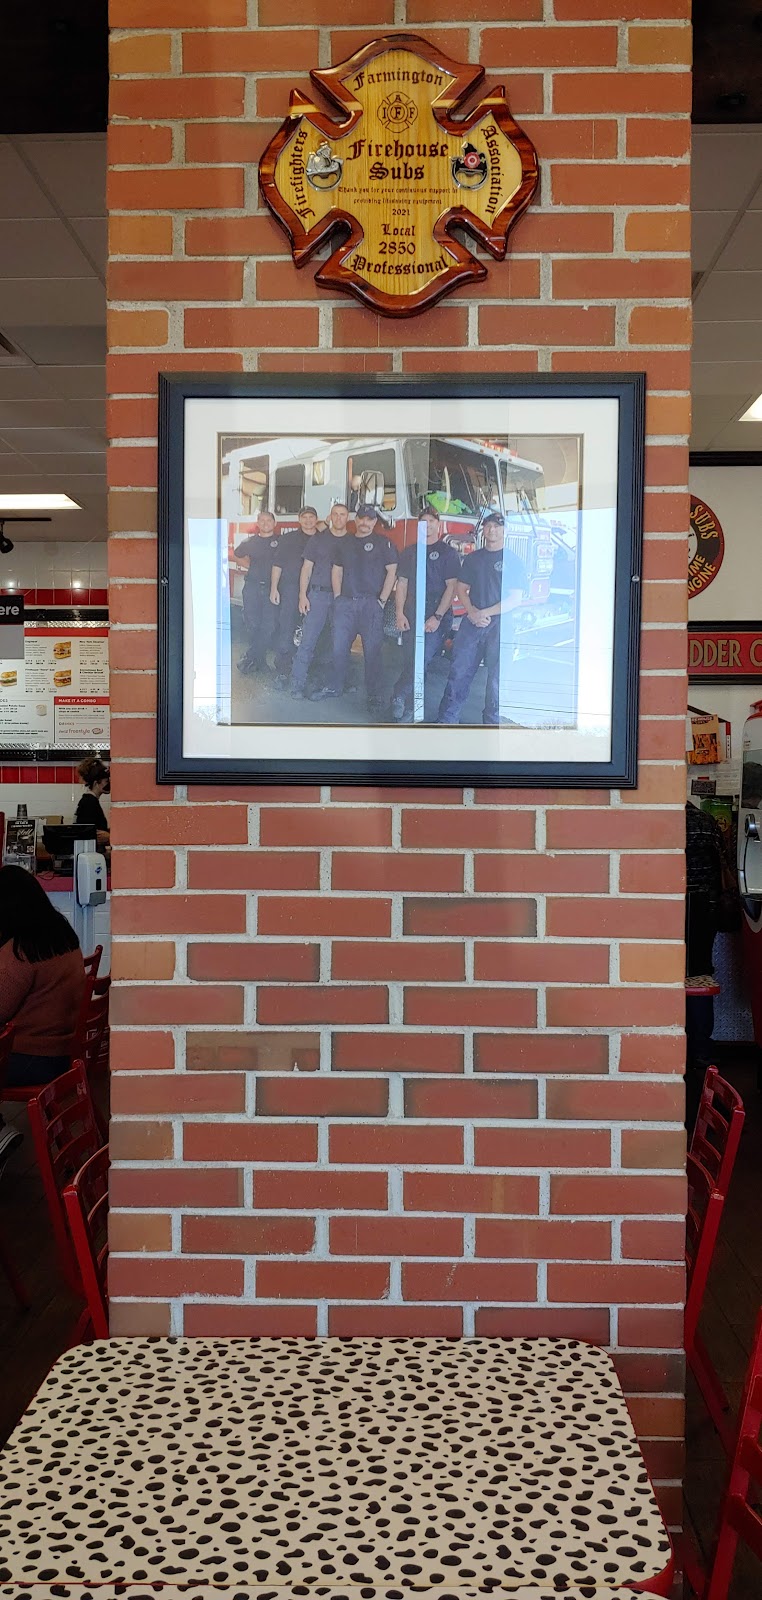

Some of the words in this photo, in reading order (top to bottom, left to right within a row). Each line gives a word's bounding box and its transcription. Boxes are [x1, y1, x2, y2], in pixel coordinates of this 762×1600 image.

[353, 68, 443, 91] Farmington
[346, 139, 449, 160] Firehouse
[289, 128, 315, 218] Firefighters
[369, 162, 424, 180] Subs
[480, 125, 504, 214] Association
[392, 208, 410, 216] 2021
[381, 223, 415, 236] Local
[379, 241, 416, 254] 2850
[350, 254, 448, 275] Professional
[690, 505, 718, 539] SUBS
[688, 554, 706, 576] IME
[688, 562, 716, 594] NGINE
[0, 606, 20, 615] ere
[689, 640, 742, 667] DDER
